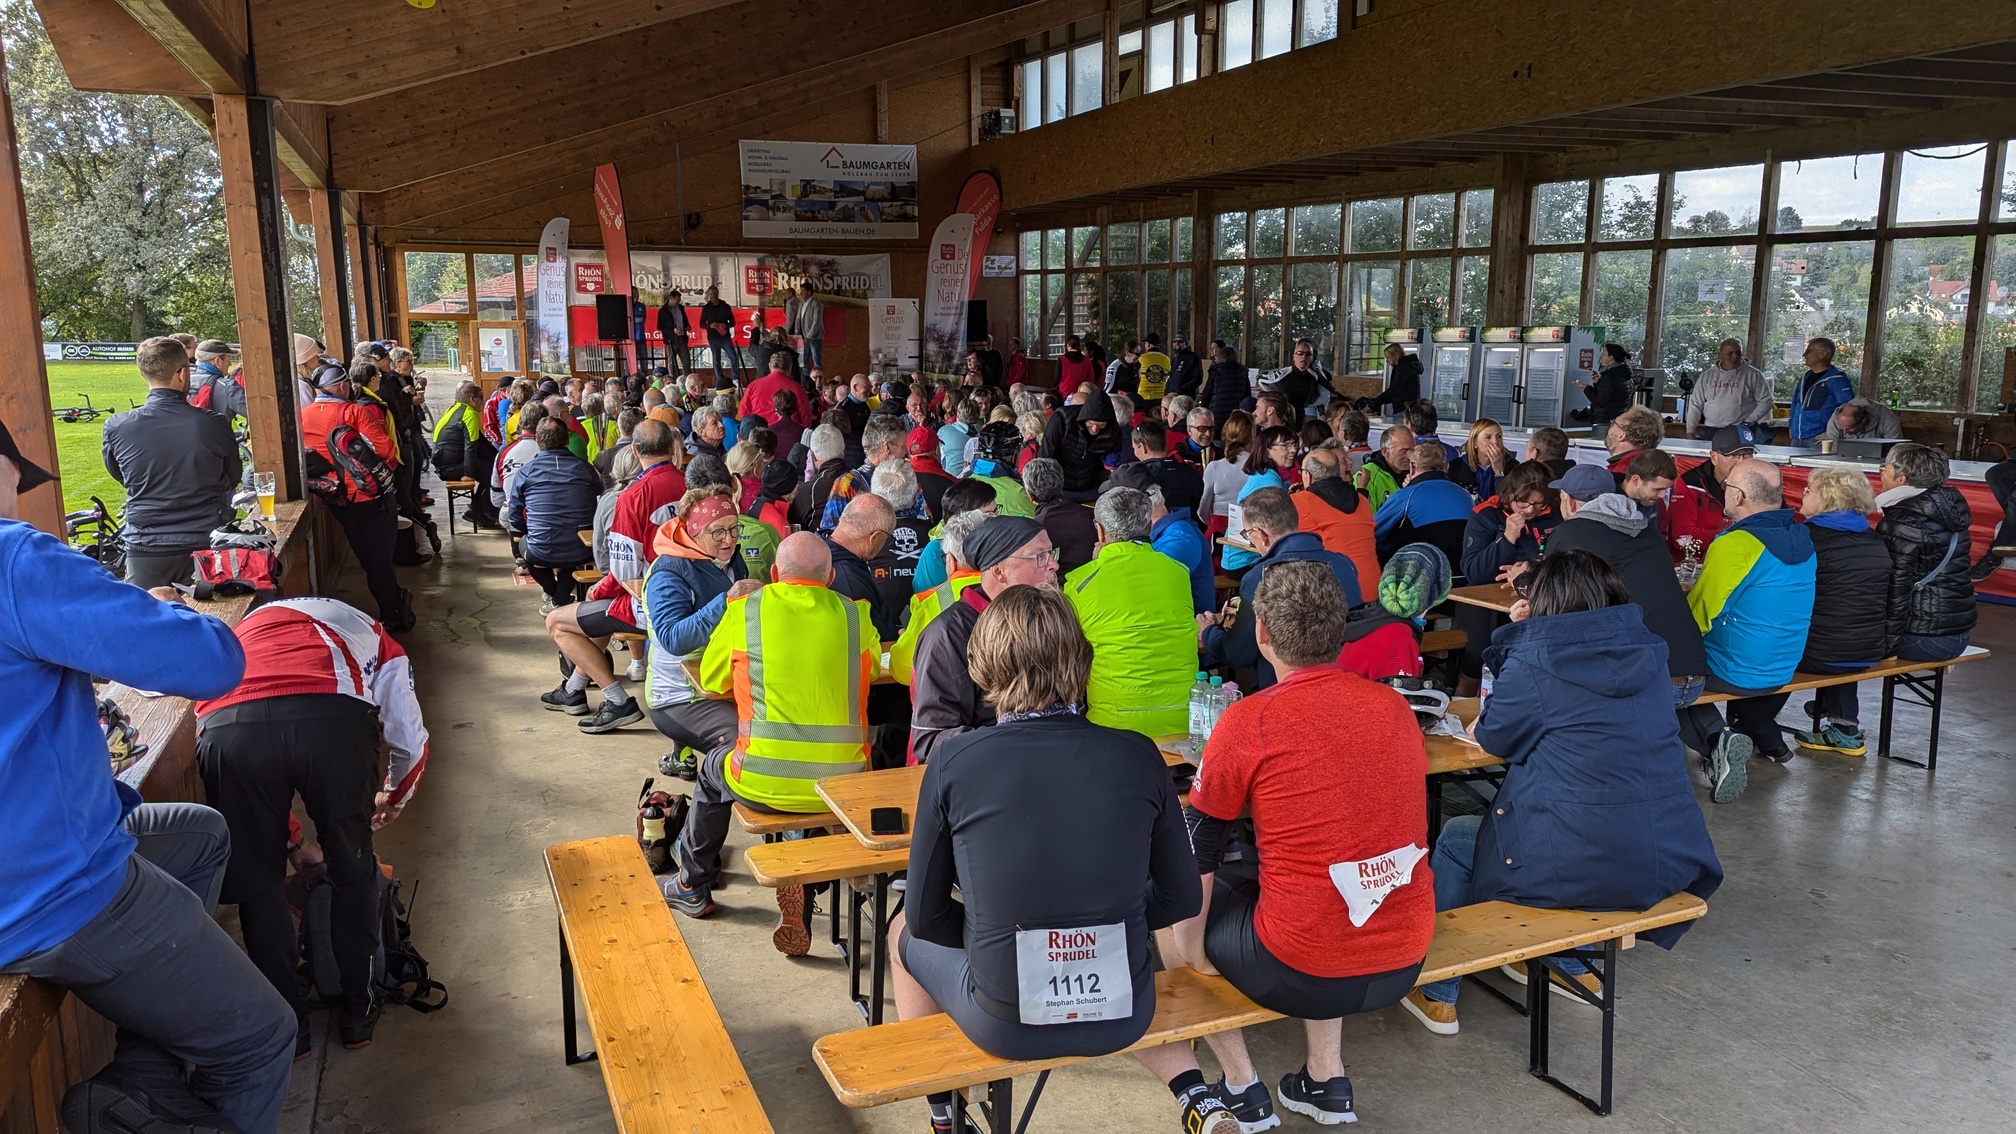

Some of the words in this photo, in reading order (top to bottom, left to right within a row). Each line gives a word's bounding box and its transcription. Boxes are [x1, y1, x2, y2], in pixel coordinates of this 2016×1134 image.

[842, 160, 911, 171] BAUMGARTEN
[973, 193, 999, 226] parkasse
[789, 226, 876, 236] BAUMGARTEN-BAUEN.DE
[974, 216, 993, 236] Fulda
[558, 251, 568, 263] De
[957, 248, 969, 260] De
[539, 261, 566, 276] Genus
[578, 266, 602, 276] RHÖN
[748, 269, 770, 278] RHÖN
[545, 289, 564, 304] Natu
[937, 288, 960, 303] Natu
[880, 314, 905, 324] Genuss
[608, 538, 634, 554] RHÖN
[610, 552, 635, 562] PRUDEL
[1357, 855, 1397, 879] RHÖN
[1048, 929, 1097, 949] RHÖN
[1048, 949, 1098, 963] SPRUDEL
[1048, 972, 1102, 997] 1112
[1045, 999, 1075, 1008] Stephan
[1075, 996, 1107, 1005] Schubert
